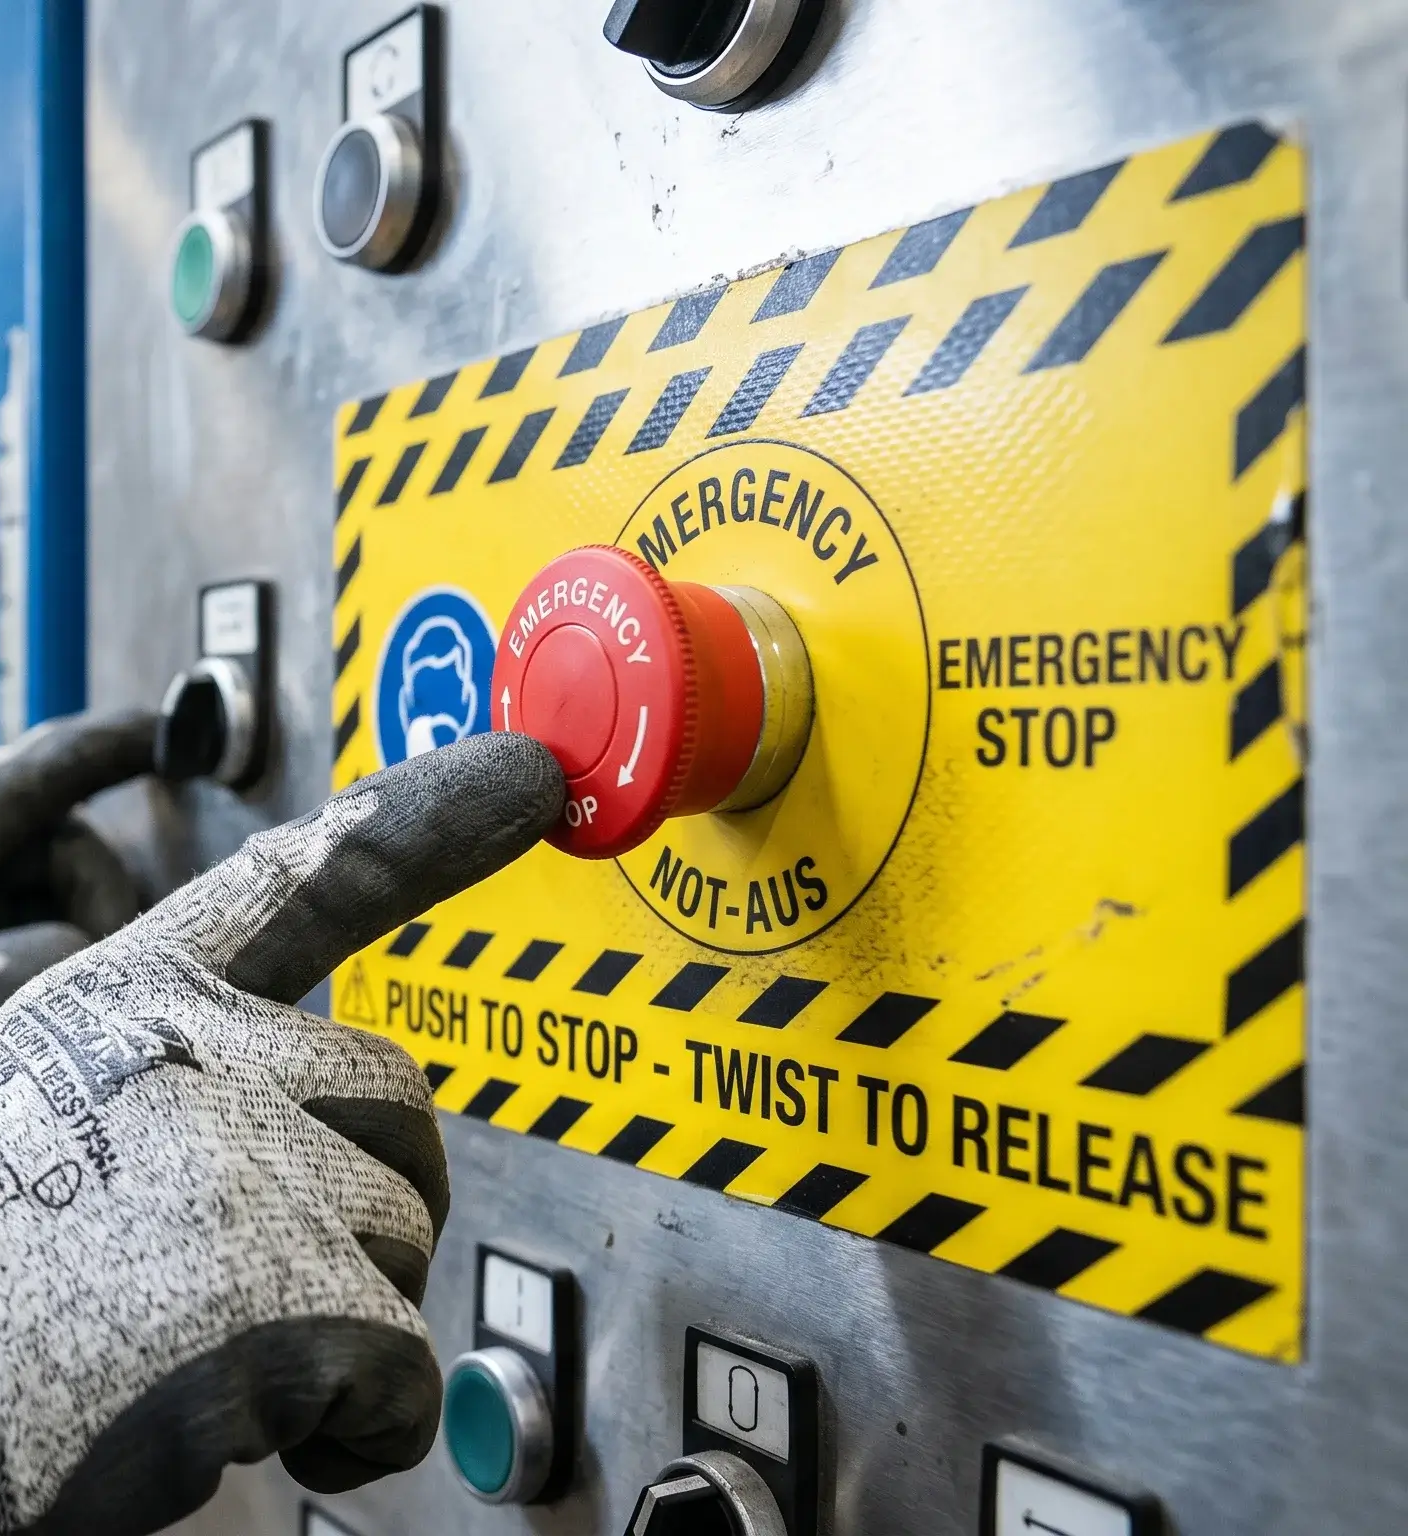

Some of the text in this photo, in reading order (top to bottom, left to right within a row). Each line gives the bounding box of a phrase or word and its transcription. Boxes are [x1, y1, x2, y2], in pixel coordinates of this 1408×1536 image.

[636, 467, 879, 586] MERGENCY
[508, 576, 652, 668] EMERGENCY
[937, 624, 1246, 690] EMERGENCY
[976, 706, 1117, 768] STOP
[565, 795, 598, 827] OP
[649, 845, 828, 934] NOT-AUS
[387, 979, 468, 1045] PUSH
[481, 1000, 525, 1060] TO
[536, 1012, 638, 1084] STOP
[687, 1039, 840, 1135] TWIST
[856, 1075, 928, 1157] TO
[952, 1093, 1269, 1239] RELEASE
